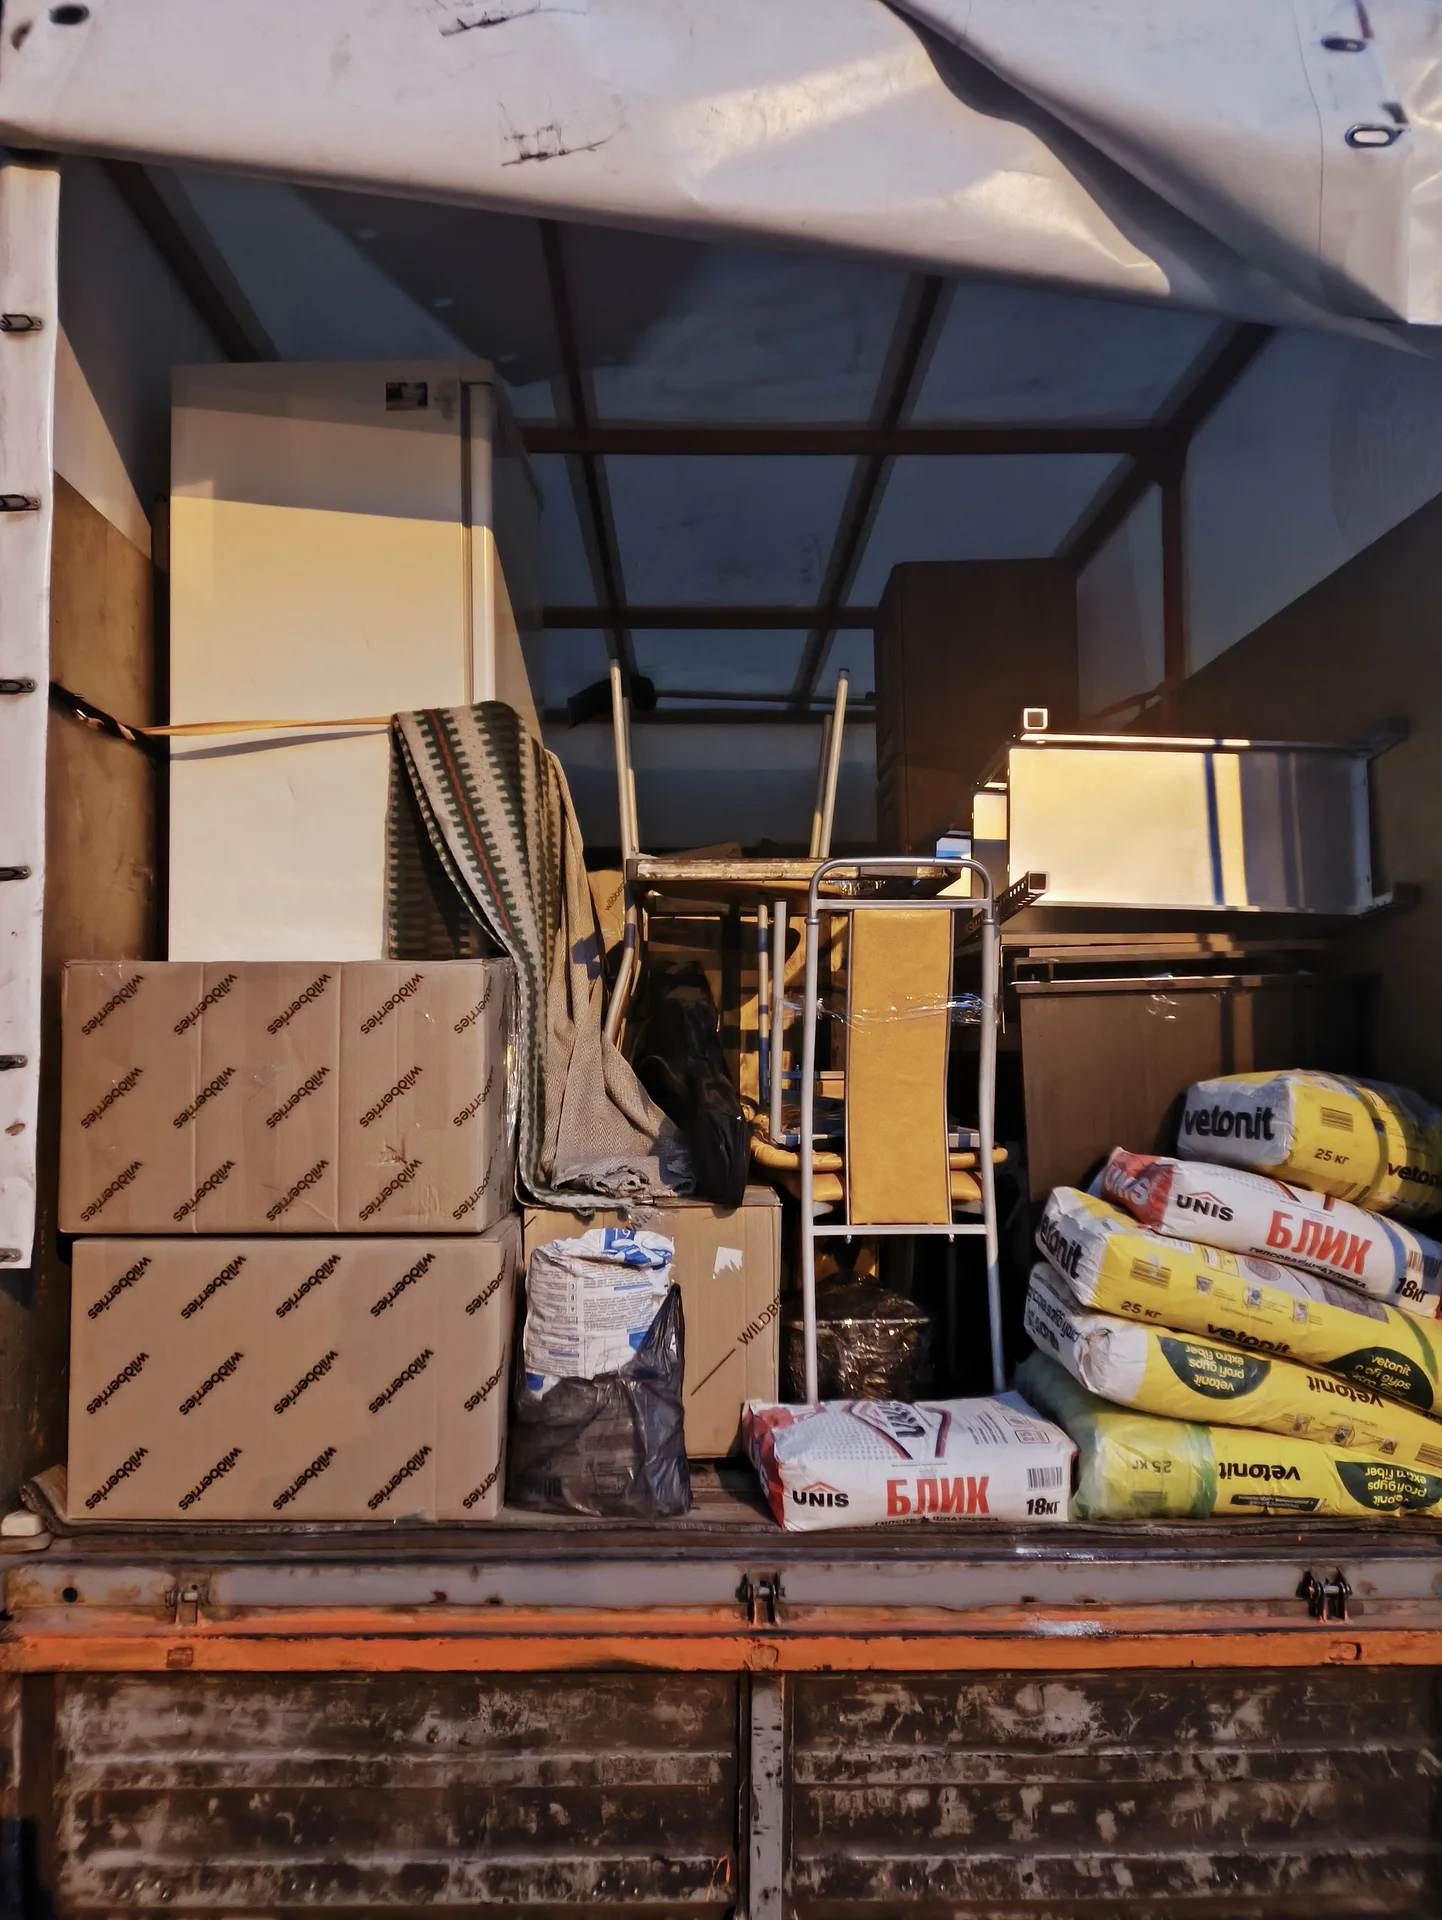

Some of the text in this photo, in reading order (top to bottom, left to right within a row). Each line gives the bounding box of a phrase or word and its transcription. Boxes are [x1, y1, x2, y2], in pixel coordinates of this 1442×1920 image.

[82, 975, 145, 1036] wildberries
[173, 974, 237, 1036] wildberries
[267, 974, 332, 1035] wildberries
[360, 973, 424, 1035] wildberries
[453, 975, 493, 1035] berries
[81, 1067, 144, 1129] wildberries
[173, 1067, 236, 1129] wildberries
[266, 1067, 330, 1129] wildberries
[360, 1066, 423, 1128] wildberries
[453, 1065, 495, 1128] berries
[1184, 1105, 1275, 1141] vetonit
[1315, 1148, 1333, 1161] 25
[1388, 1162, 1442, 1188] veton
[80, 1161, 143, 1222] wildberries
[173, 1160, 236, 1222] wildberries
[266, 1160, 330, 1222] wildberries
[359, 1159, 422, 1221] wildberries
[452, 1156, 493, 1221] berries
[1177, 1194, 1234, 1221] UNIS
[1266, 1210, 1372, 1275] БЛИК
[87, 1257, 152, 1320] wildberries
[181, 1256, 247, 1319] wildberries
[276, 1254, 341, 1318] wildberries
[370, 1253, 436, 1317] wildberries
[465, 1249, 507, 1316] berries
[1121, 1301, 1142, 1314] 25
[1185, 1345, 1244, 1367] extra fiber
[1189, 1358, 1245, 1379] profi gyps
[1207, 1323, 1292, 1353] vetonit
[1371, 1355, 1412, 1377] vetonit
[86, 1352, 150, 1415] wildberries
[179, 1352, 244, 1415] wildberries
[274, 1350, 339, 1414] wildberries
[368, 1348, 434, 1414] wildberries
[464, 1343, 506, 1412] berries
[1193, 1374, 1234, 1392] vetonit
[1307, 1375, 1385, 1408] vetonit
[1355, 1364, 1412, 1390] pofi gyps
[85, 1447, 149, 1510] wildberries
[179, 1447, 243, 1510] wildberries
[273, 1446, 337, 1510] wildberries
[367, 1445, 432, 1510] wildberries
[462, 1437, 505, 1510] berries
[886, 1476, 990, 1517] БЛИК
[1152, 1460, 1172, 1474] 25
[1218, 1462, 1301, 1481] vetonit
[1365, 1467, 1394, 1480] fiber
[1367, 1479, 1427, 1498] profi gyps
[792, 1490, 850, 1508] UNIS
[1372, 1494, 1409, 1507] veonit
